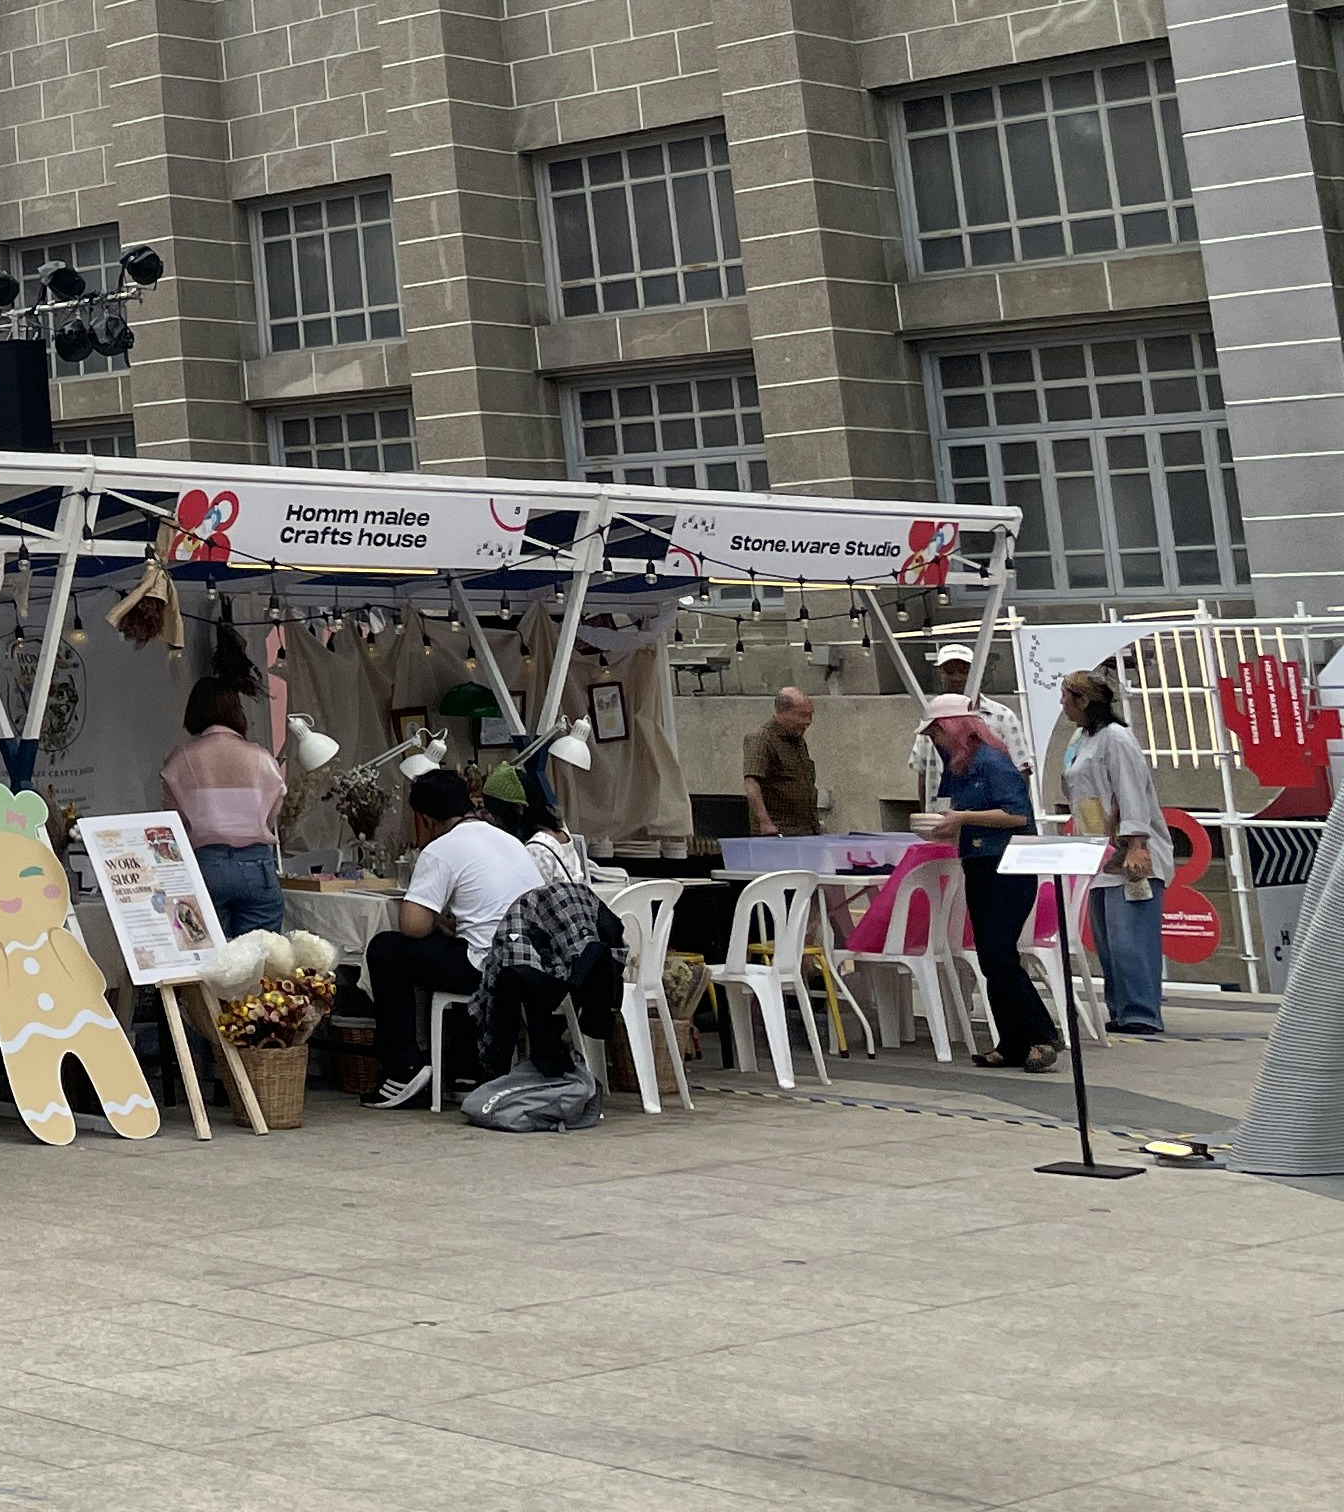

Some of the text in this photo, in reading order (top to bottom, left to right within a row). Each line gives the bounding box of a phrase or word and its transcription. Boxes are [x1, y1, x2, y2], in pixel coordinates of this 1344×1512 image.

[285, 504, 430, 527] Homm malee
[514, 506, 521, 516] 5
[280, 526, 427, 548] Crafts house
[730, 535, 901, 558] Stone.ware Studio
[673, 559, 680, 568] 4
[104, 857, 142, 870] WORK
[110, 872, 140, 886] SHOP
